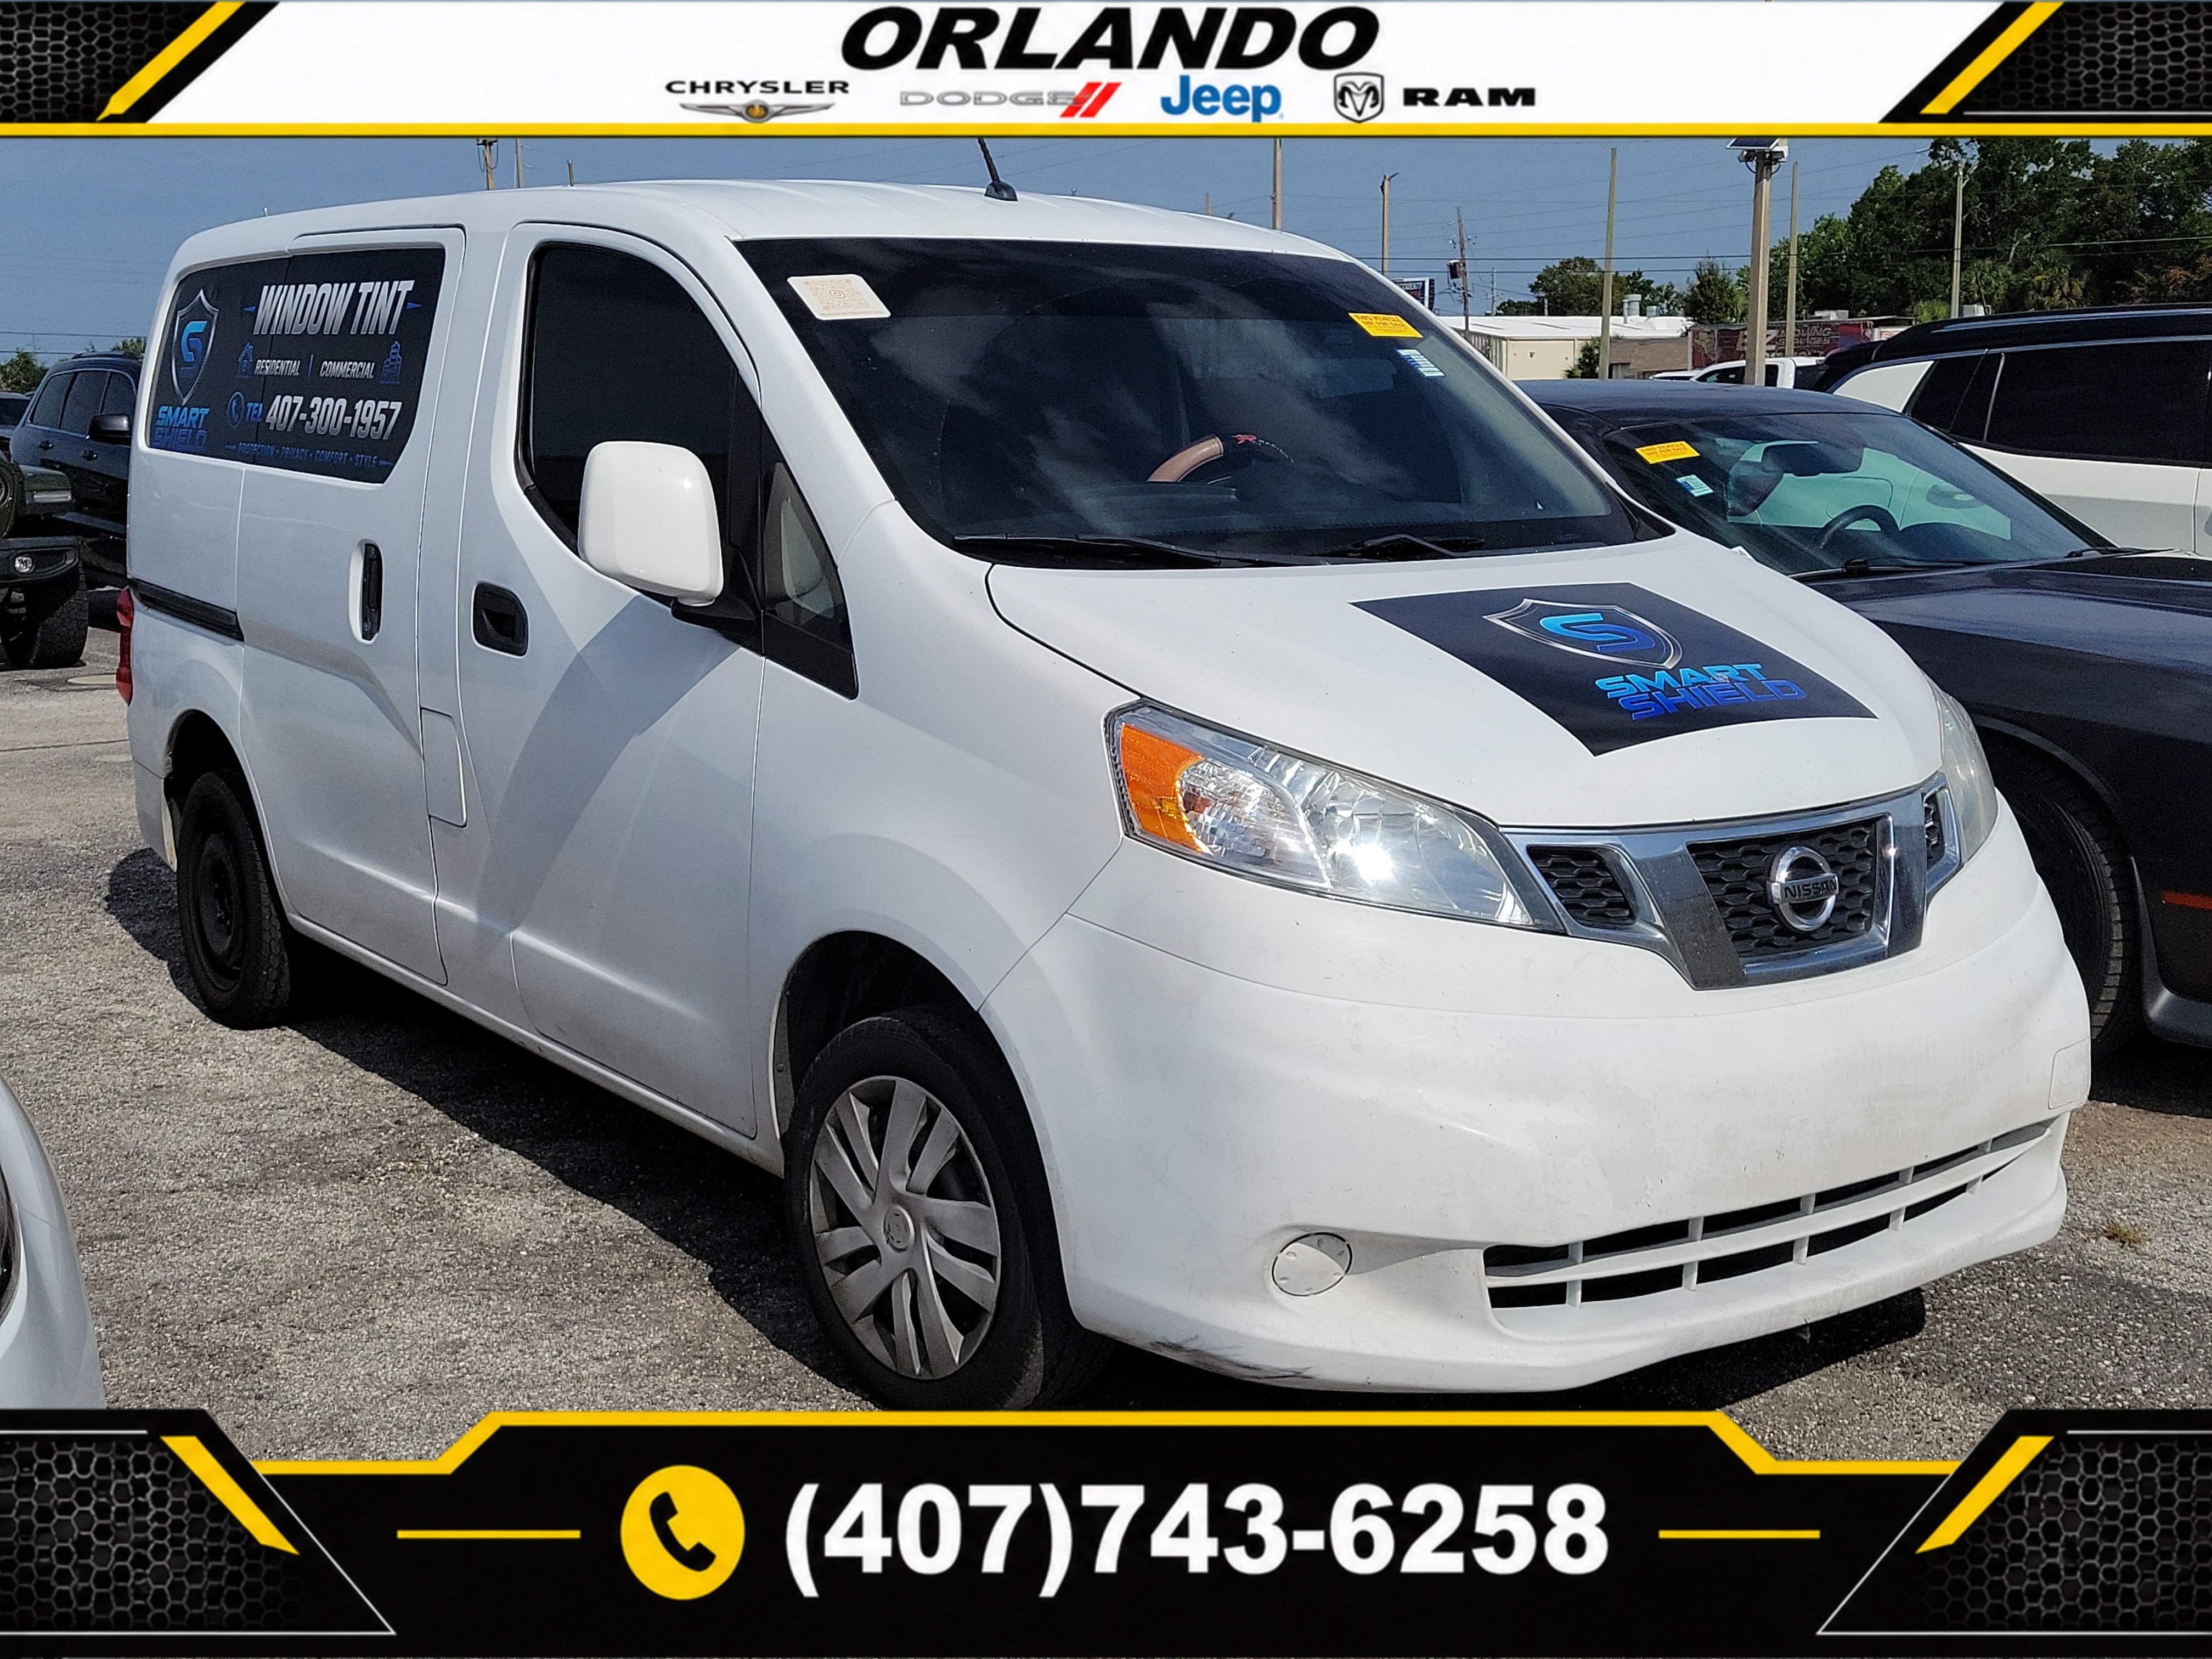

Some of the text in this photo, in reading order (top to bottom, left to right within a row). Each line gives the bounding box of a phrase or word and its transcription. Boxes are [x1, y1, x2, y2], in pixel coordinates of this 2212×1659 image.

[253, 280, 415, 335] WINDOW TINT
[254, 359, 301, 376] RESIDENTIAL
[319, 360, 375, 379] COMMERCIAL
[156, 405, 210, 428] SMART
[245, 394, 402, 441] TEL 407-300-1957
[152, 427, 207, 453] SHIELD
[1595, 663, 1767, 699] SMART
[1618, 679, 1807, 721] SHIELD
[1784, 876, 1837, 899] NISSAN
